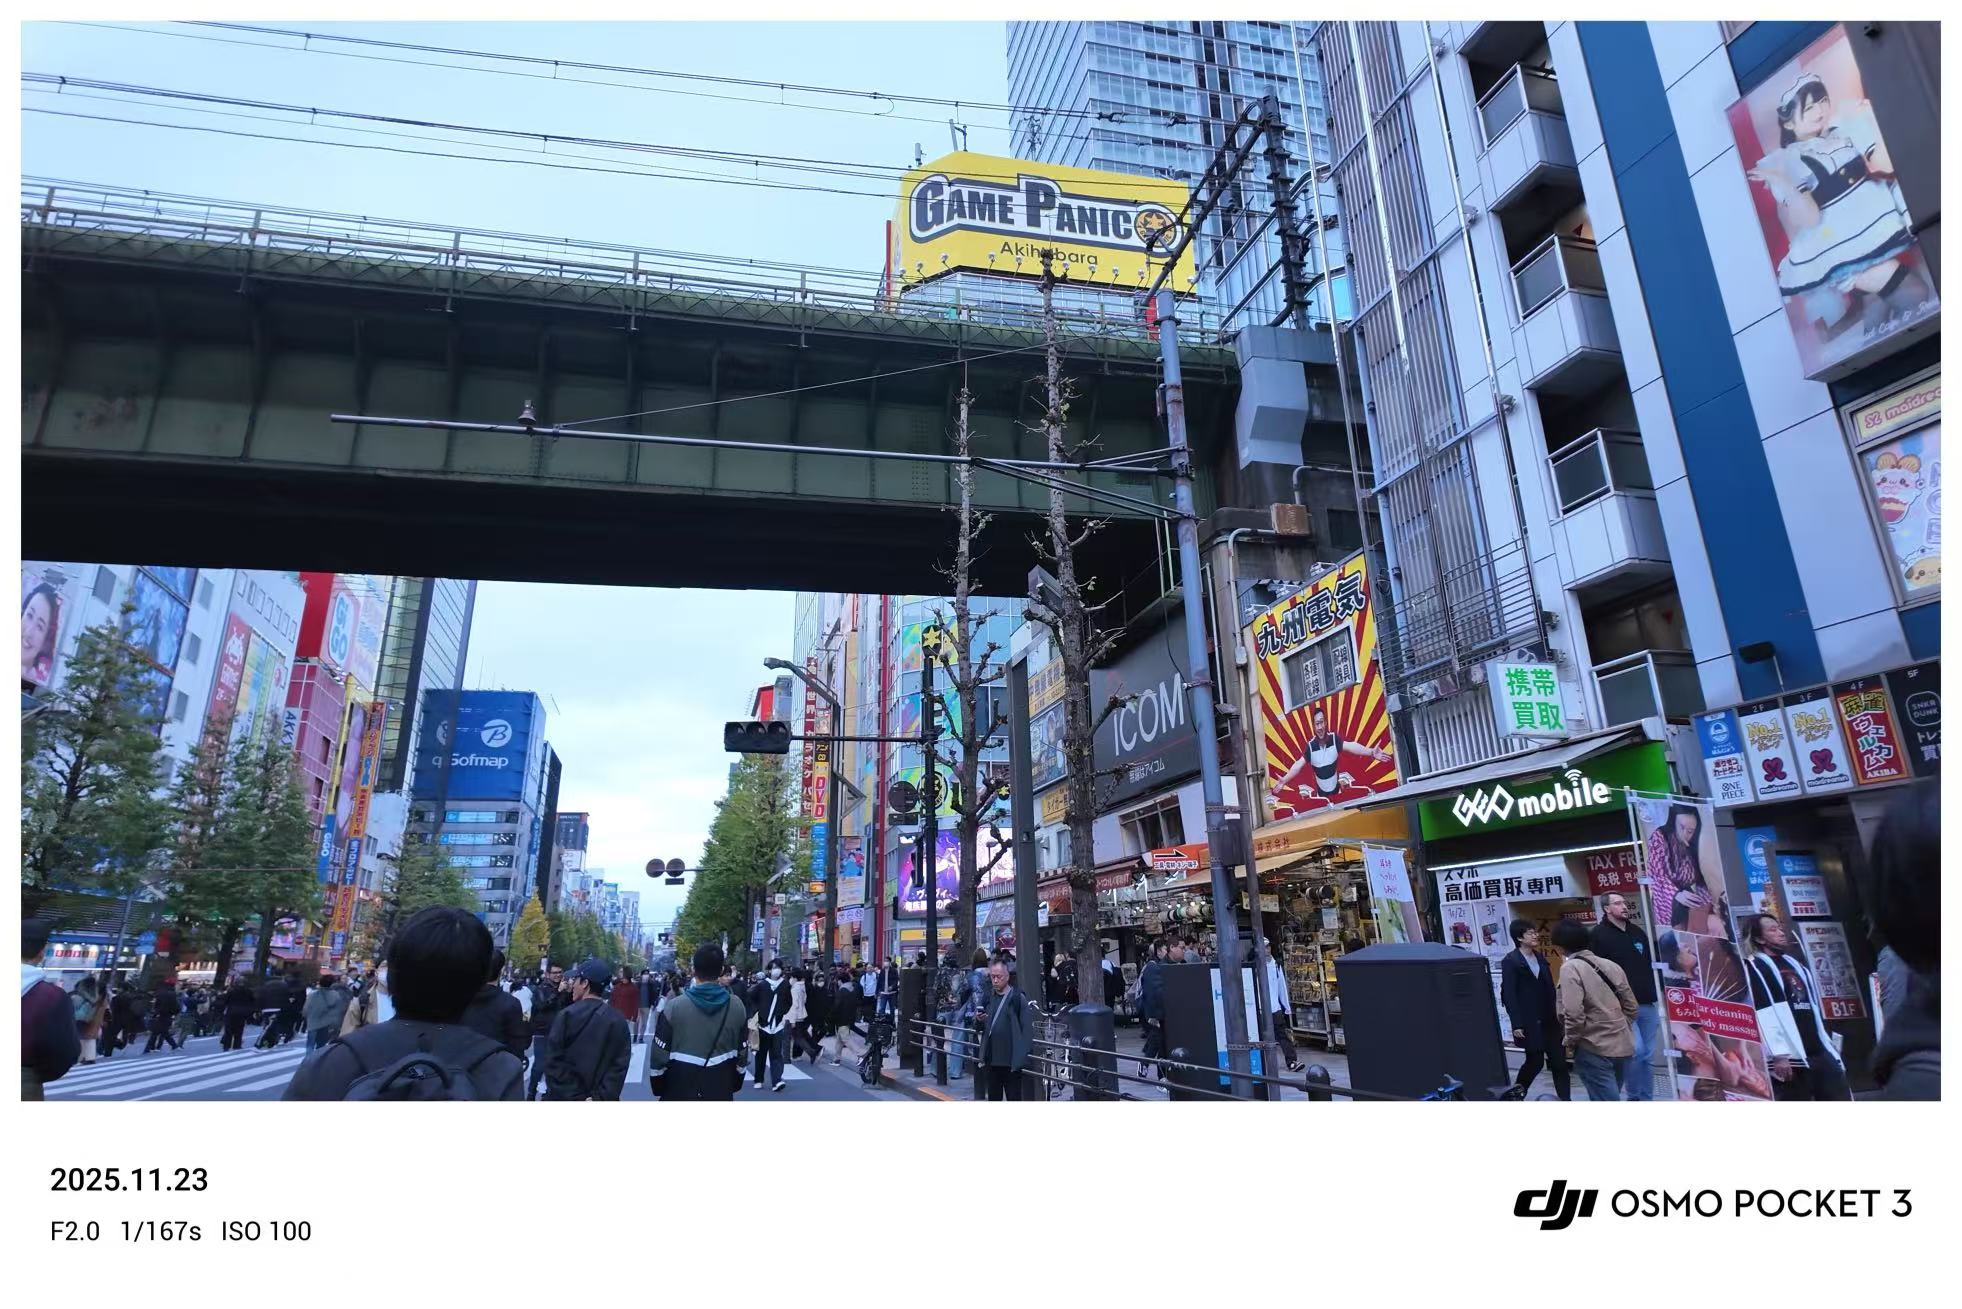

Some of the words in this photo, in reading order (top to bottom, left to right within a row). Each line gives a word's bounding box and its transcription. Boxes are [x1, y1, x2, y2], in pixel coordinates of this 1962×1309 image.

[914, 180, 1014, 233] GAME
[1025, 180, 1133, 240] PANIC
[1000, 241, 1099, 265] Akihbara
[1256, 571, 1367, 660] 九州電気
[1505, 667, 1556, 698] 携帯
[1907, 669, 1919, 678] 5F
[1842, 692, 1885, 717] 麻雀
[1911, 699, 1937, 710] SNKR
[1912, 708, 1940, 718] DUNK
[1113, 672, 1185, 756] ICOM
[1512, 701, 1564, 731] 買取
[1746, 717, 1783, 738] No.1
[1853, 715, 1894, 771] ウェルカム
[1916, 731, 1941, 743] トレ
[451, 753, 509, 769] Sofmap
[1920, 743, 1941, 762] 買
[1866, 768, 1899, 779] AKIBA
[1721, 781, 1742, 792] ONE
[1721, 789, 1745, 801] PIECE
[814, 776, 828, 818] DVD
[1518, 777, 1612, 817] mobile
[1585, 853, 1614, 871] TAX
[1444, 867, 1479, 882] スマホ
[1597, 872, 1621, 887] 免税
[1444, 875, 1565, 902] 高価買取専門
[1710, 1006, 1754, 1024] cleaning
[1830, 1000, 1857, 1017] B1F
[1719, 1022, 1758, 1039] massag
